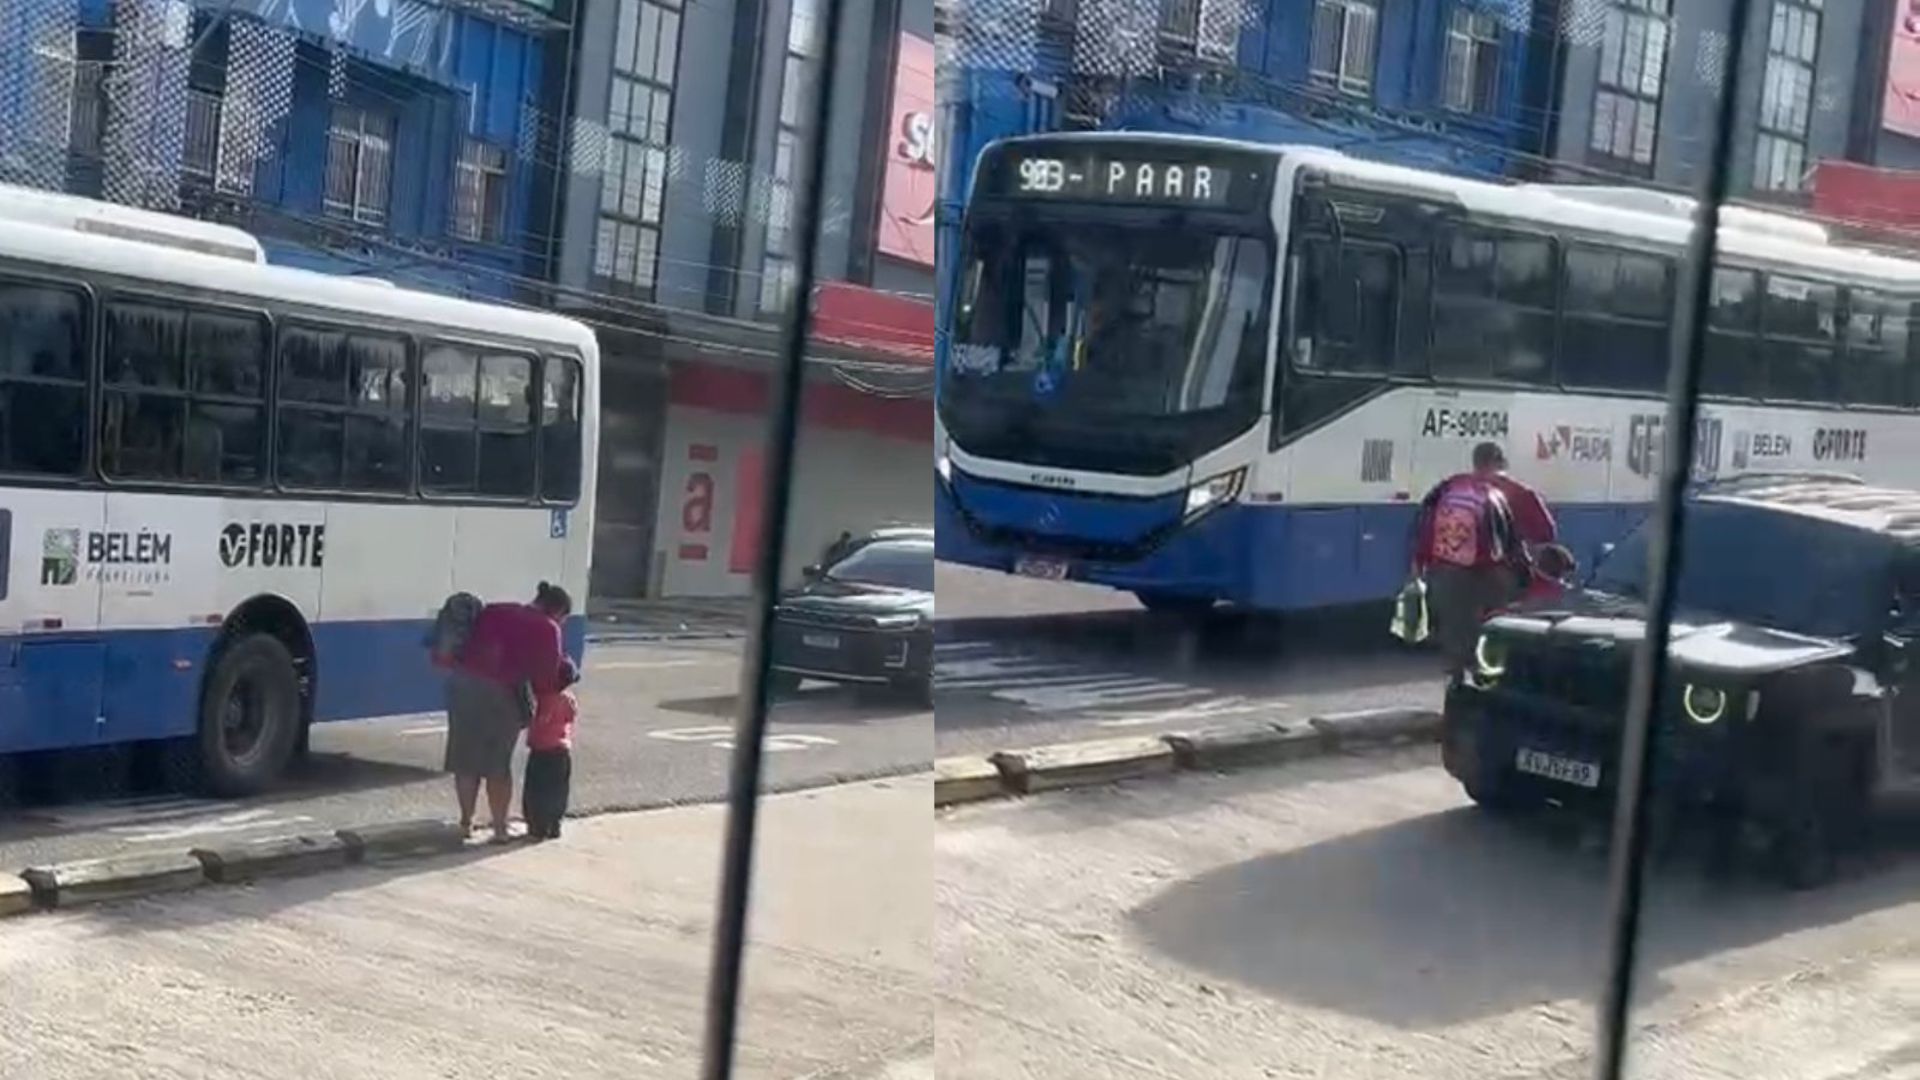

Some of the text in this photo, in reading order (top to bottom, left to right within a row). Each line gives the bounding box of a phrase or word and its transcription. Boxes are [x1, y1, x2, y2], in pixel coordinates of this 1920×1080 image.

[1107, 161, 1212, 199] PAAR
[88, 526, 172, 564] BELÉM
[248, 523, 325, 567] FORTE
